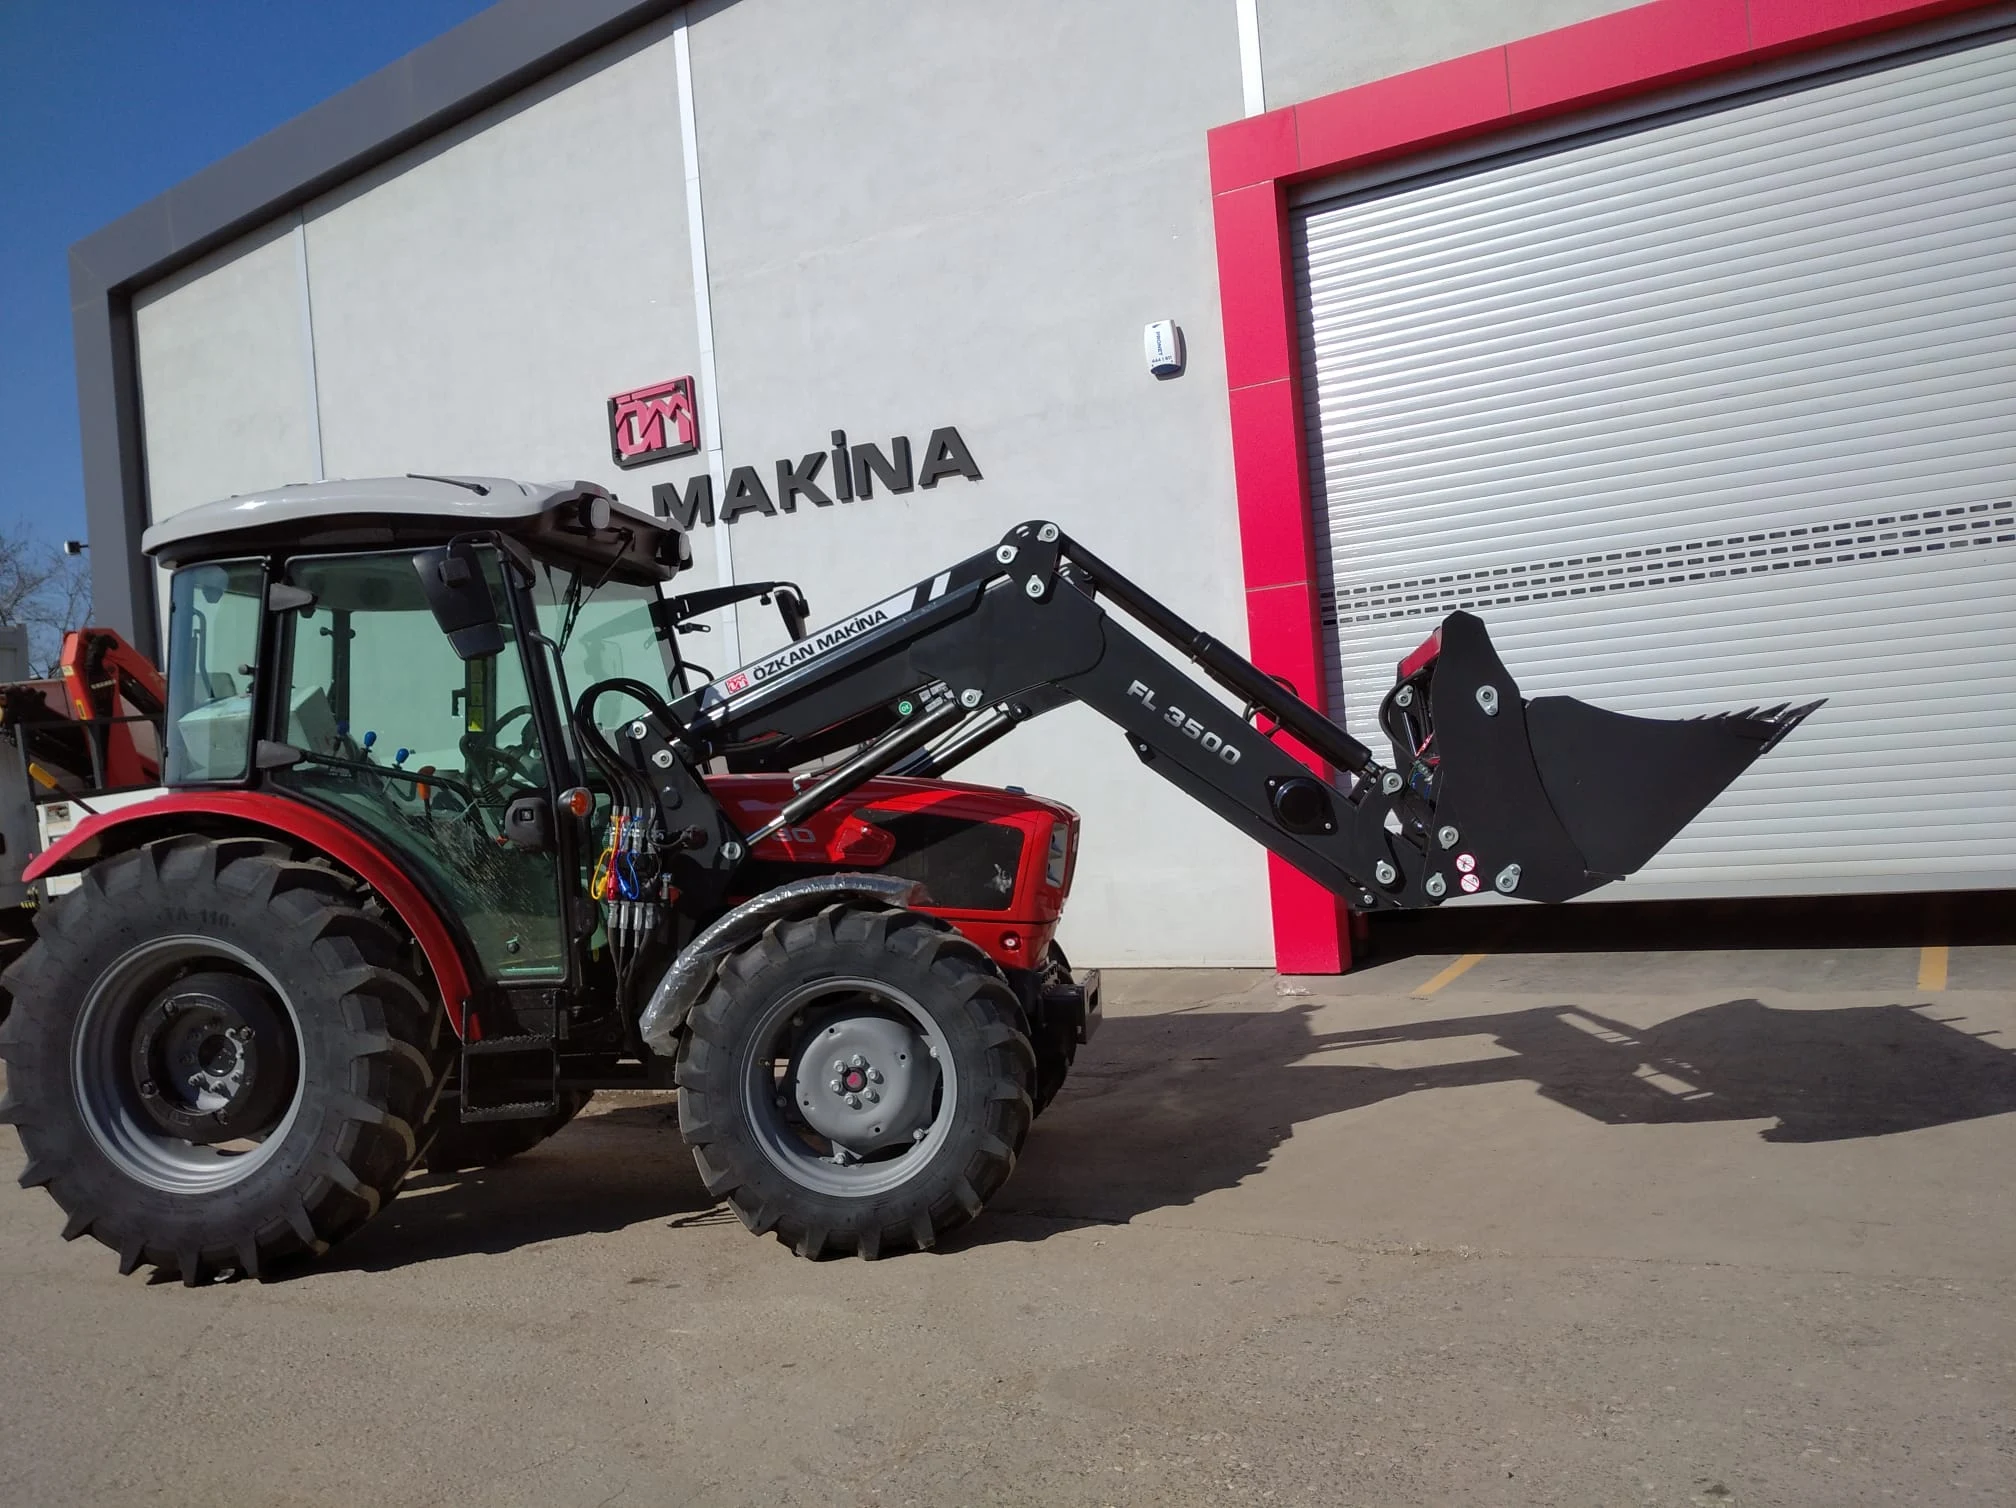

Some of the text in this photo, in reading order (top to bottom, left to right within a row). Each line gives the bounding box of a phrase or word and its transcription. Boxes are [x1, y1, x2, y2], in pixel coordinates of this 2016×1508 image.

[652, 426, 983, 531] MAKİNA
[753, 643, 815, 681] ÖZKAN
[816, 610, 888, 651] MAKİNA
[1126, 679, 1241, 766] FL 3500
